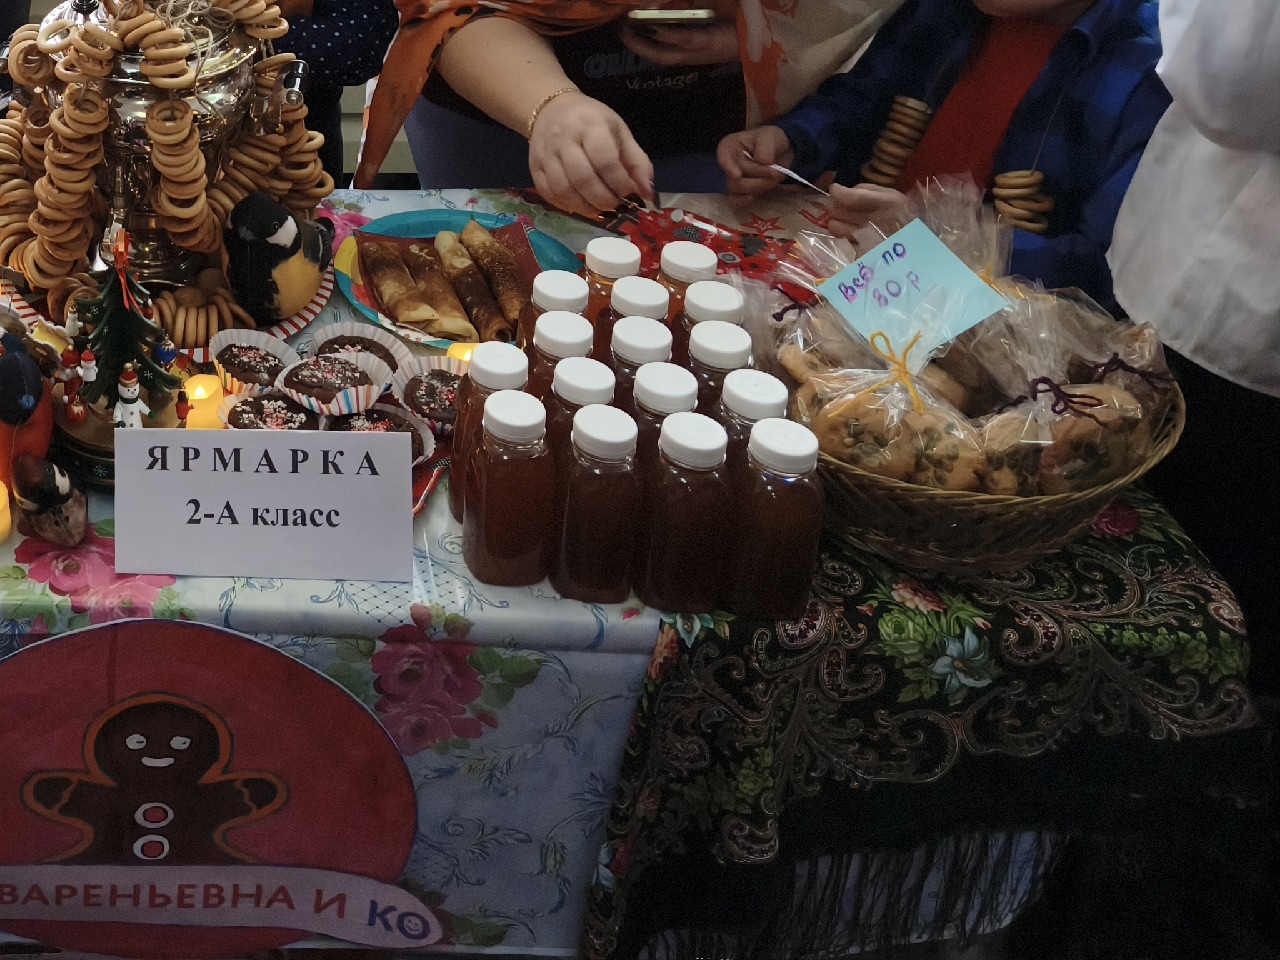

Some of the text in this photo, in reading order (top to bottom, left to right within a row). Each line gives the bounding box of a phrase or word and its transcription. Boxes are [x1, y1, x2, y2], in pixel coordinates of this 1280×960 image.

[145, 445, 380, 476] ЯРМАРКА
[185, 498, 340, 528] 2-А класс
[313, 888, 347, 919] И
[367, 899, 431, 940] КО
